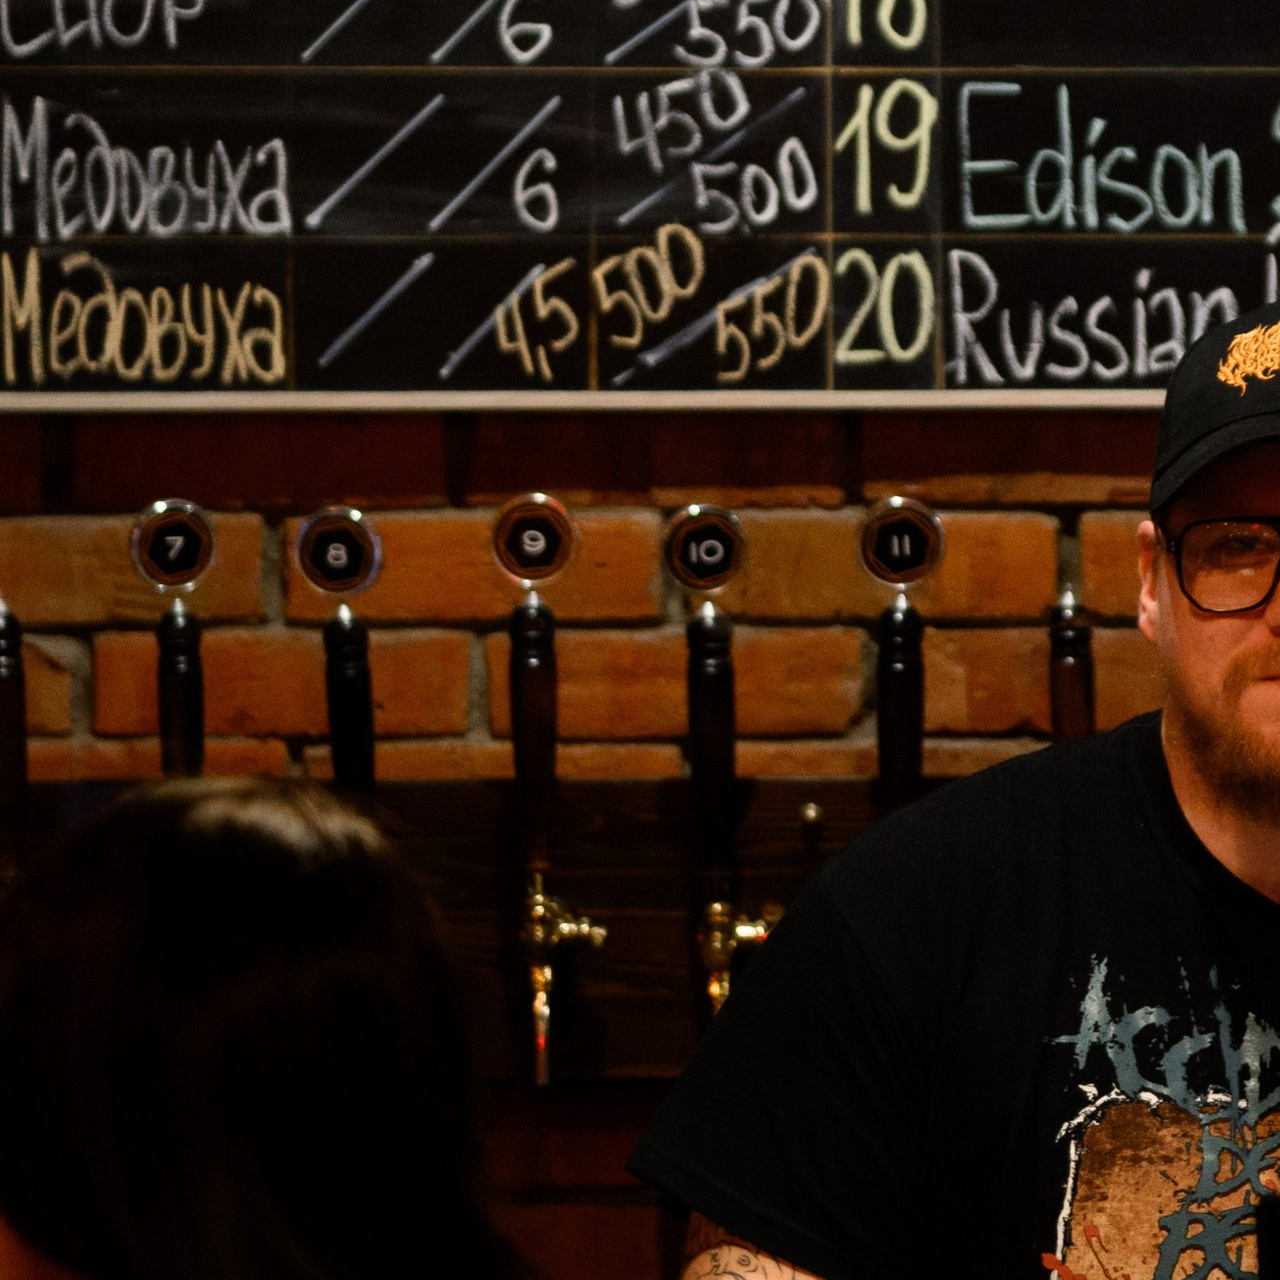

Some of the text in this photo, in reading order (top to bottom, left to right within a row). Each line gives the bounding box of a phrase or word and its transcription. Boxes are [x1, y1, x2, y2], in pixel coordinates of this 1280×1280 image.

[612, 68, 750, 173] 450
[835, 78, 938, 216] 19
[958, 82, 1246, 233] Edison
[513, 148, 559, 232] 6
[689, 136, 817, 234] 500
[593, 224, 703, 347] 500
[715, 254, 830, 383] 550
[833, 249, 935, 364] 20
[947, 248, 1238, 385] Russian
[164, 535, 185, 560] 7
[326, 542, 348, 569] 8
[522, 529, 546, 555] 9
[688, 538, 725, 566] 10
